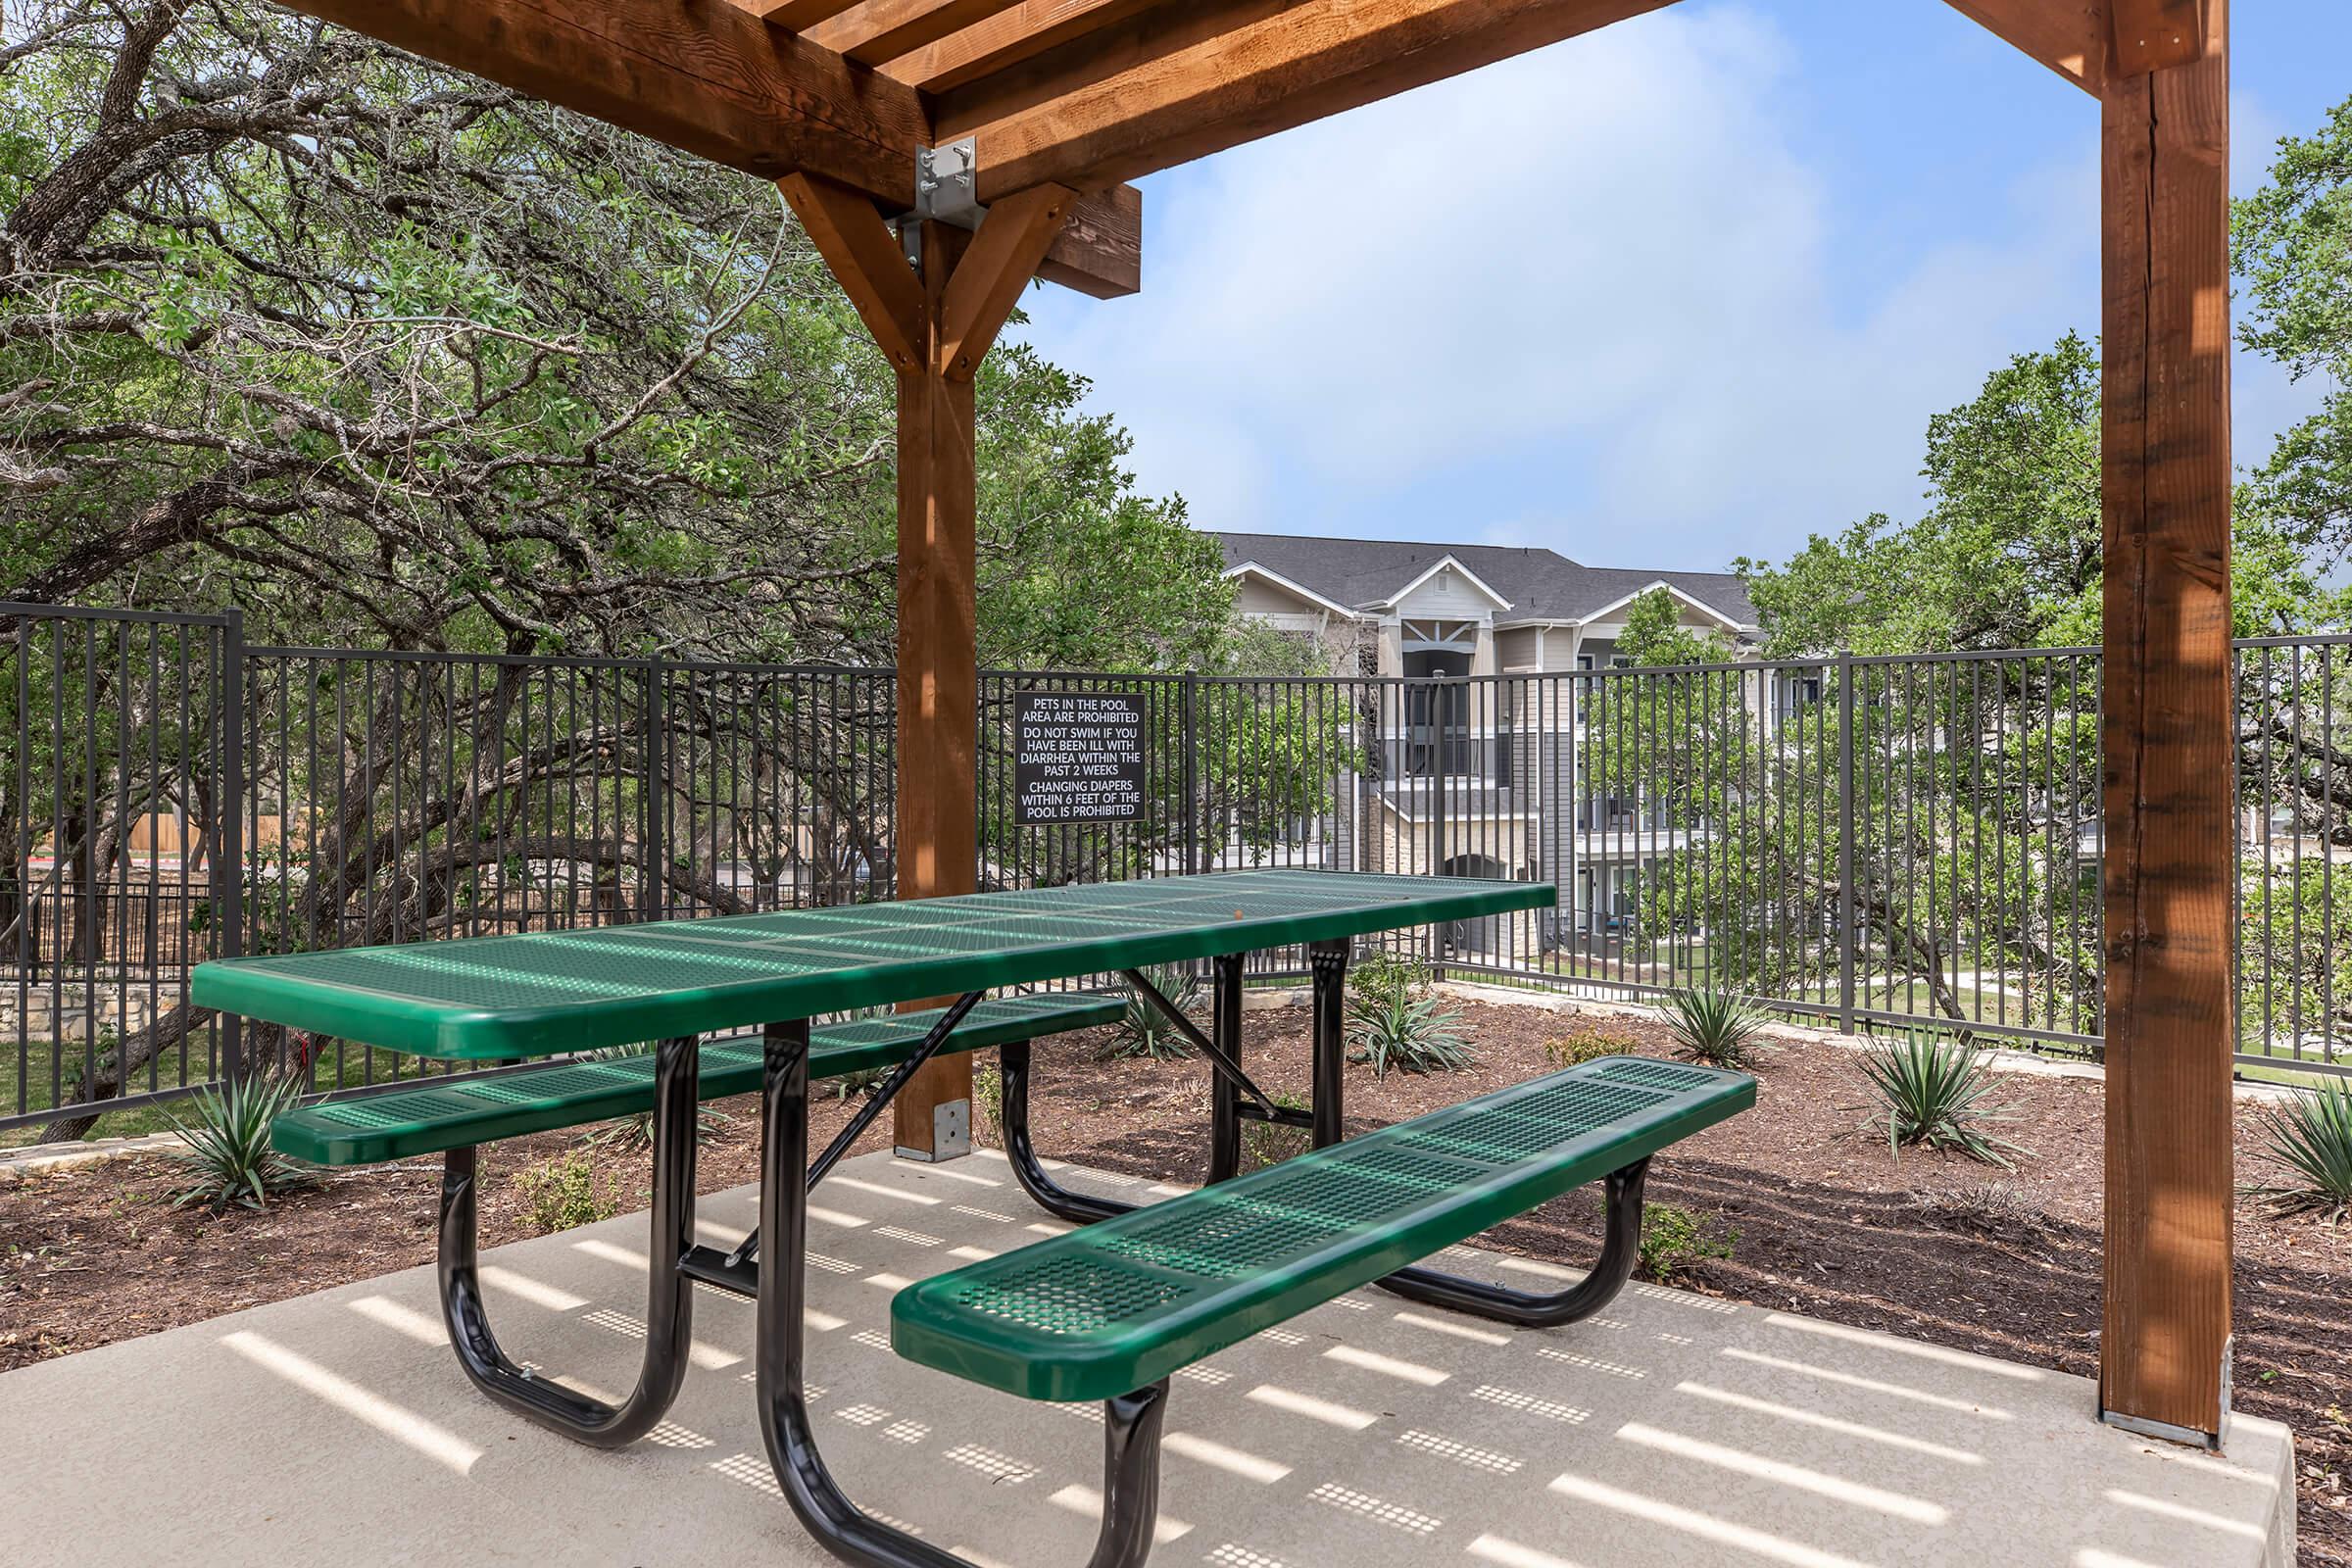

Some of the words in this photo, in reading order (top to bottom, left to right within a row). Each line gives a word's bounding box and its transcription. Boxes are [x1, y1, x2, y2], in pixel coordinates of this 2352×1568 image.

[1034, 699, 1059, 709] PETS
[1063, 699, 1073, 709] IN
[1077, 699, 1097, 710] THE
[1101, 700, 1129, 710] POOL
[1022, 712, 1051, 722] AREA
[1054, 712, 1074, 722] ARE
[1078, 712, 1138, 722] PROHIBITED
[1024, 728, 1040, 738] DO
[1045, 728, 1067, 738] NOT
[1071, 728, 1099, 738] SWIM
[1104, 728, 1112, 738] IF
[1116, 728, 1137, 738] YOU
[1027, 740, 1056, 751] HAVE
[1060, 740, 1086, 751] BEEN
[1090, 740, 1104, 750] ILL
[1107, 740, 1134, 750] WITH
[1021, 753, 1075, 764] DIARRHEA
[1078, 753, 1117, 763] WITHIN
[1121, 753, 1140, 762] THE
[1044, 766, 1070, 776] PAST
[1074, 766, 1079, 775] 2
[1083, 765, 1118, 775] WEEKS
[1030, 781, 1087, 792] CHANGING
[1090, 780, 1132, 791] DIAPERS
[1021, 794, 1062, 805] WITHIN
[1066, 794, 1072, 804] 6
[1076, 793, 1099, 804] FEET
[1103, 793, 1117, 803] OF
[1120, 792, 1140, 802] THE
[1028, 807, 1057, 818] POOL
[1061, 807, 1069, 817] IS
[1073, 805, 1134, 816] PROHIBITED
